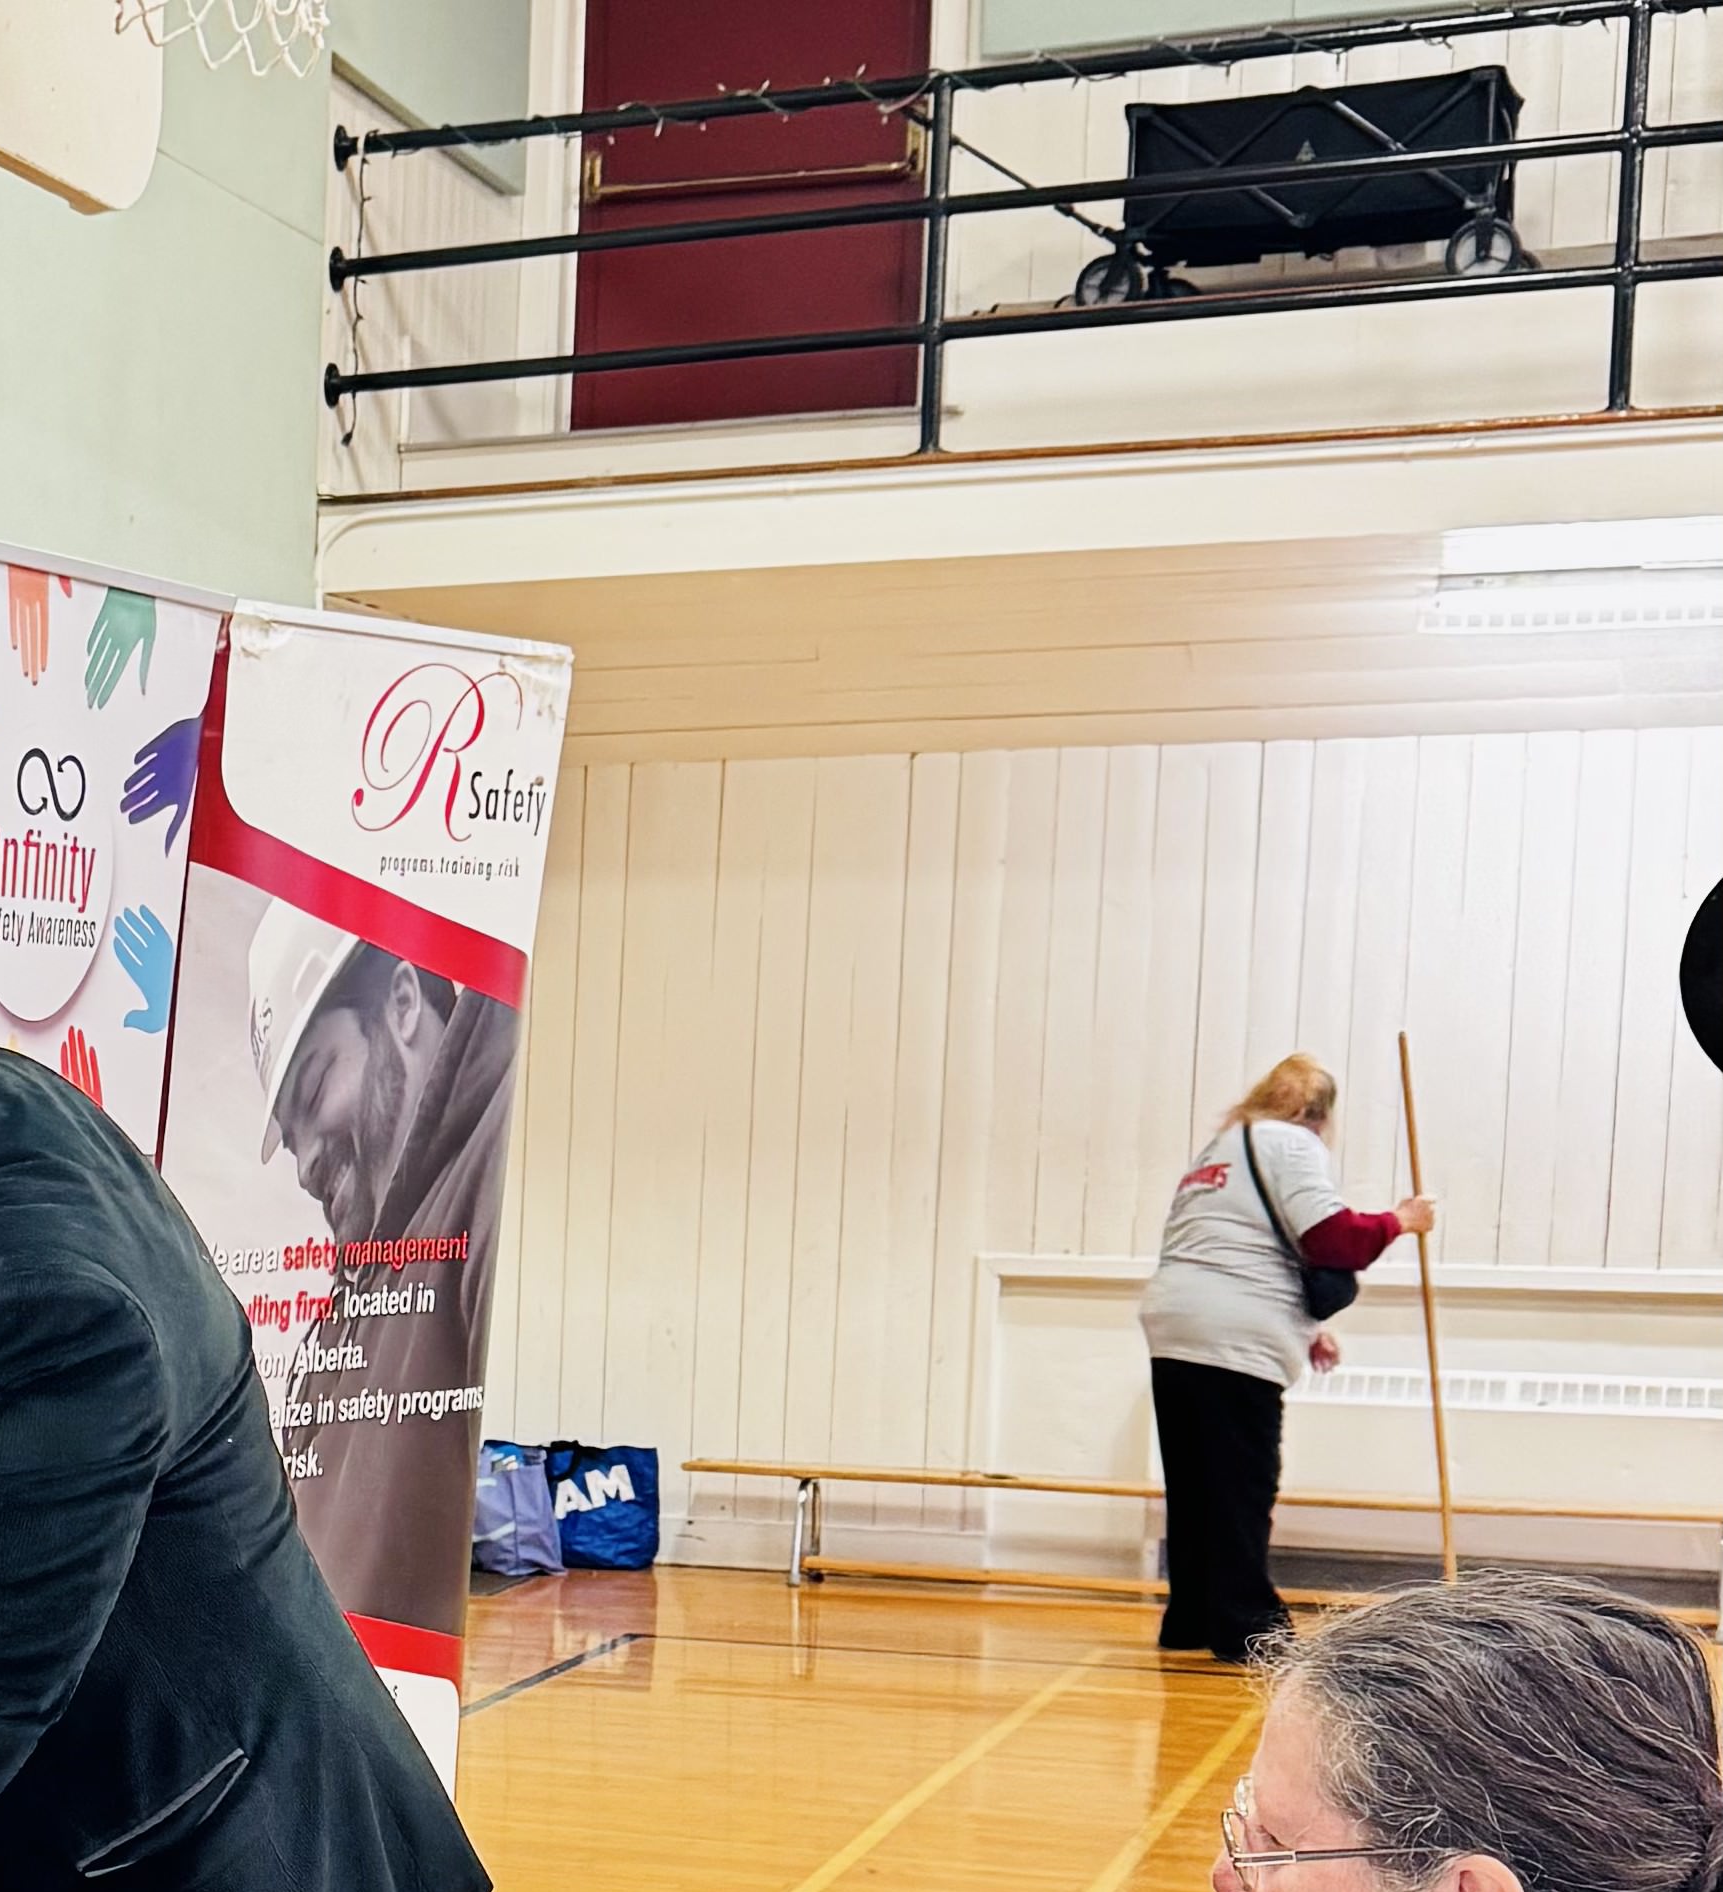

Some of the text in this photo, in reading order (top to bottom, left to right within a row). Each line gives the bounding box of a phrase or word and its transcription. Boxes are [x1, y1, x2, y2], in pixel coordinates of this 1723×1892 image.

[351, 663, 546, 841] R Safety
[27, 911, 96, 948] Awareness
[232, 1253, 262, 1275] are
[265, 1253, 278, 1272] a
[283, 1237, 337, 1275] safety
[344, 1231, 468, 1271] management
[344, 1283, 412, 1319] located
[415, 1285, 436, 1313] in
[293, 1339, 368, 1374] Alberta.
[317, 1394, 335, 1424] in
[338, 1388, 395, 1425] safety
